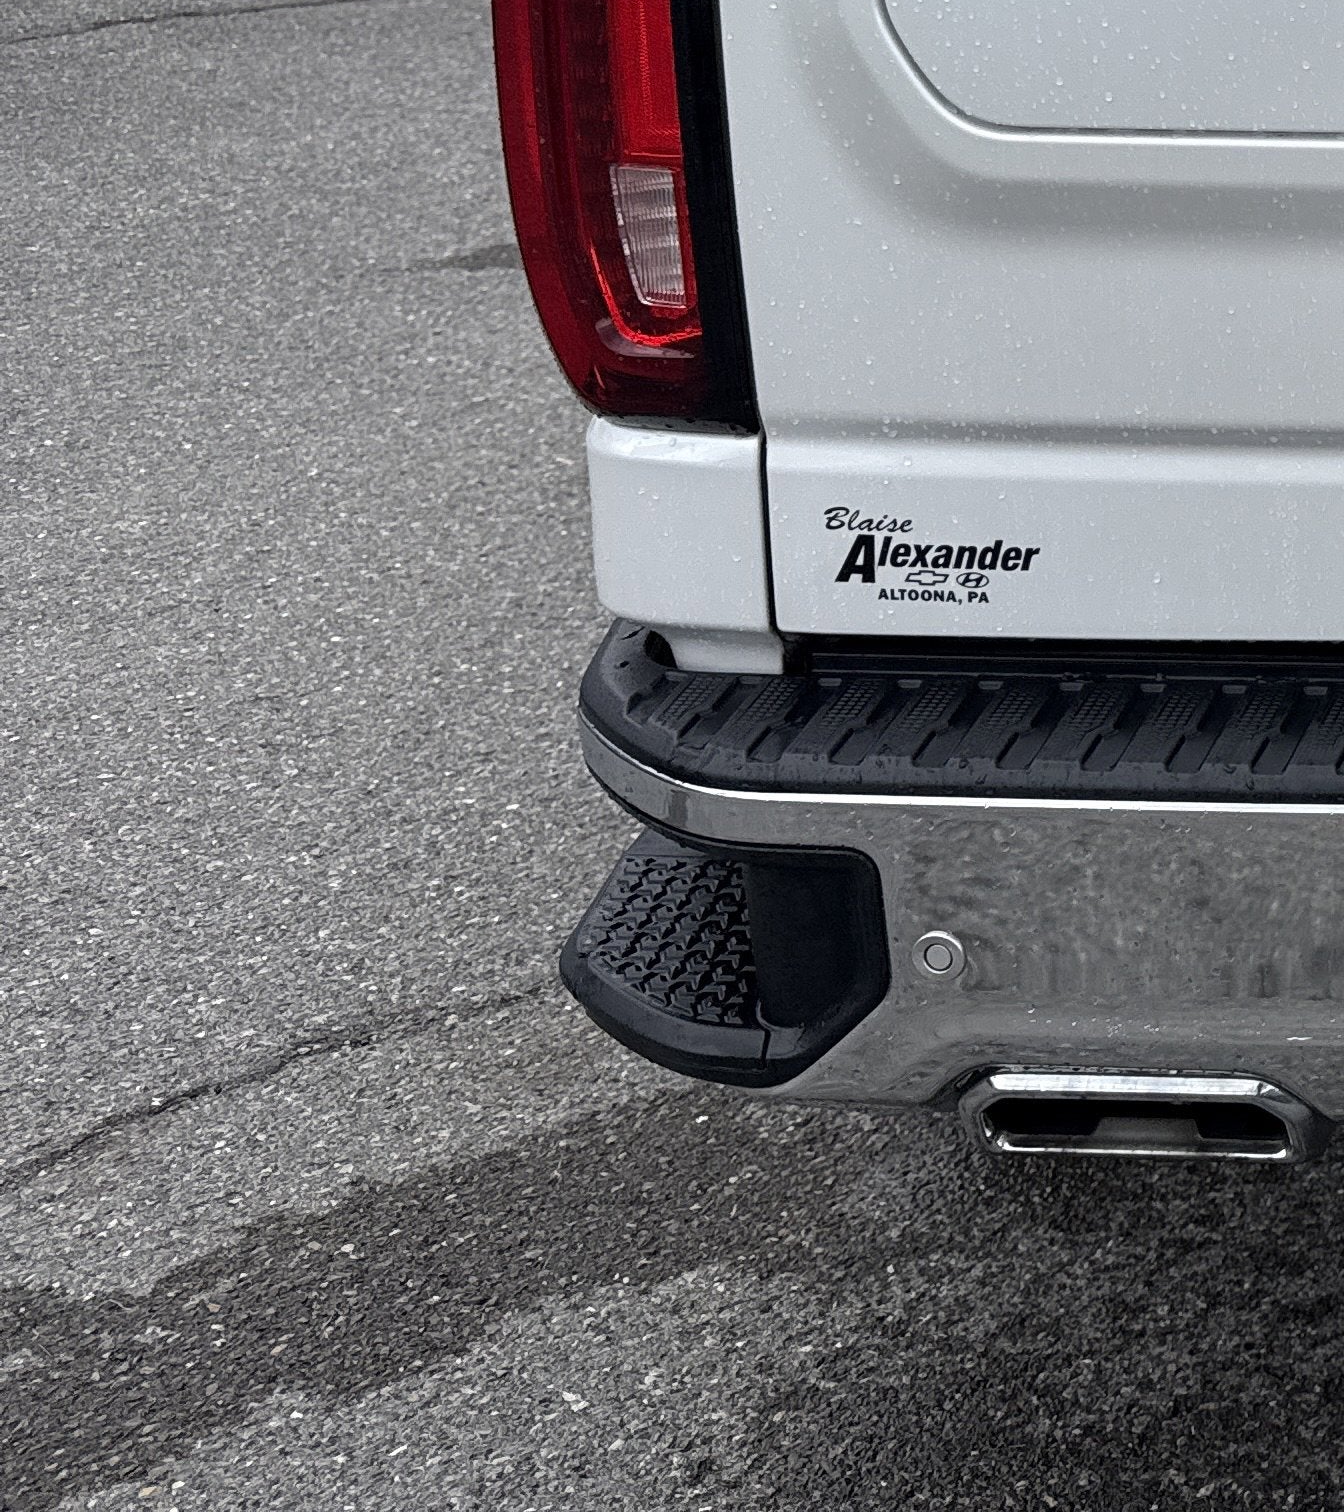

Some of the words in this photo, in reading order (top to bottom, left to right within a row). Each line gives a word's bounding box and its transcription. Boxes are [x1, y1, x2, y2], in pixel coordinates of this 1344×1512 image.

[823, 506, 913, 533] Blaise
[834, 534, 1041, 584] Alexander
[878, 588, 963, 605] ALTOONA,
[967, 591, 989, 604] PA
